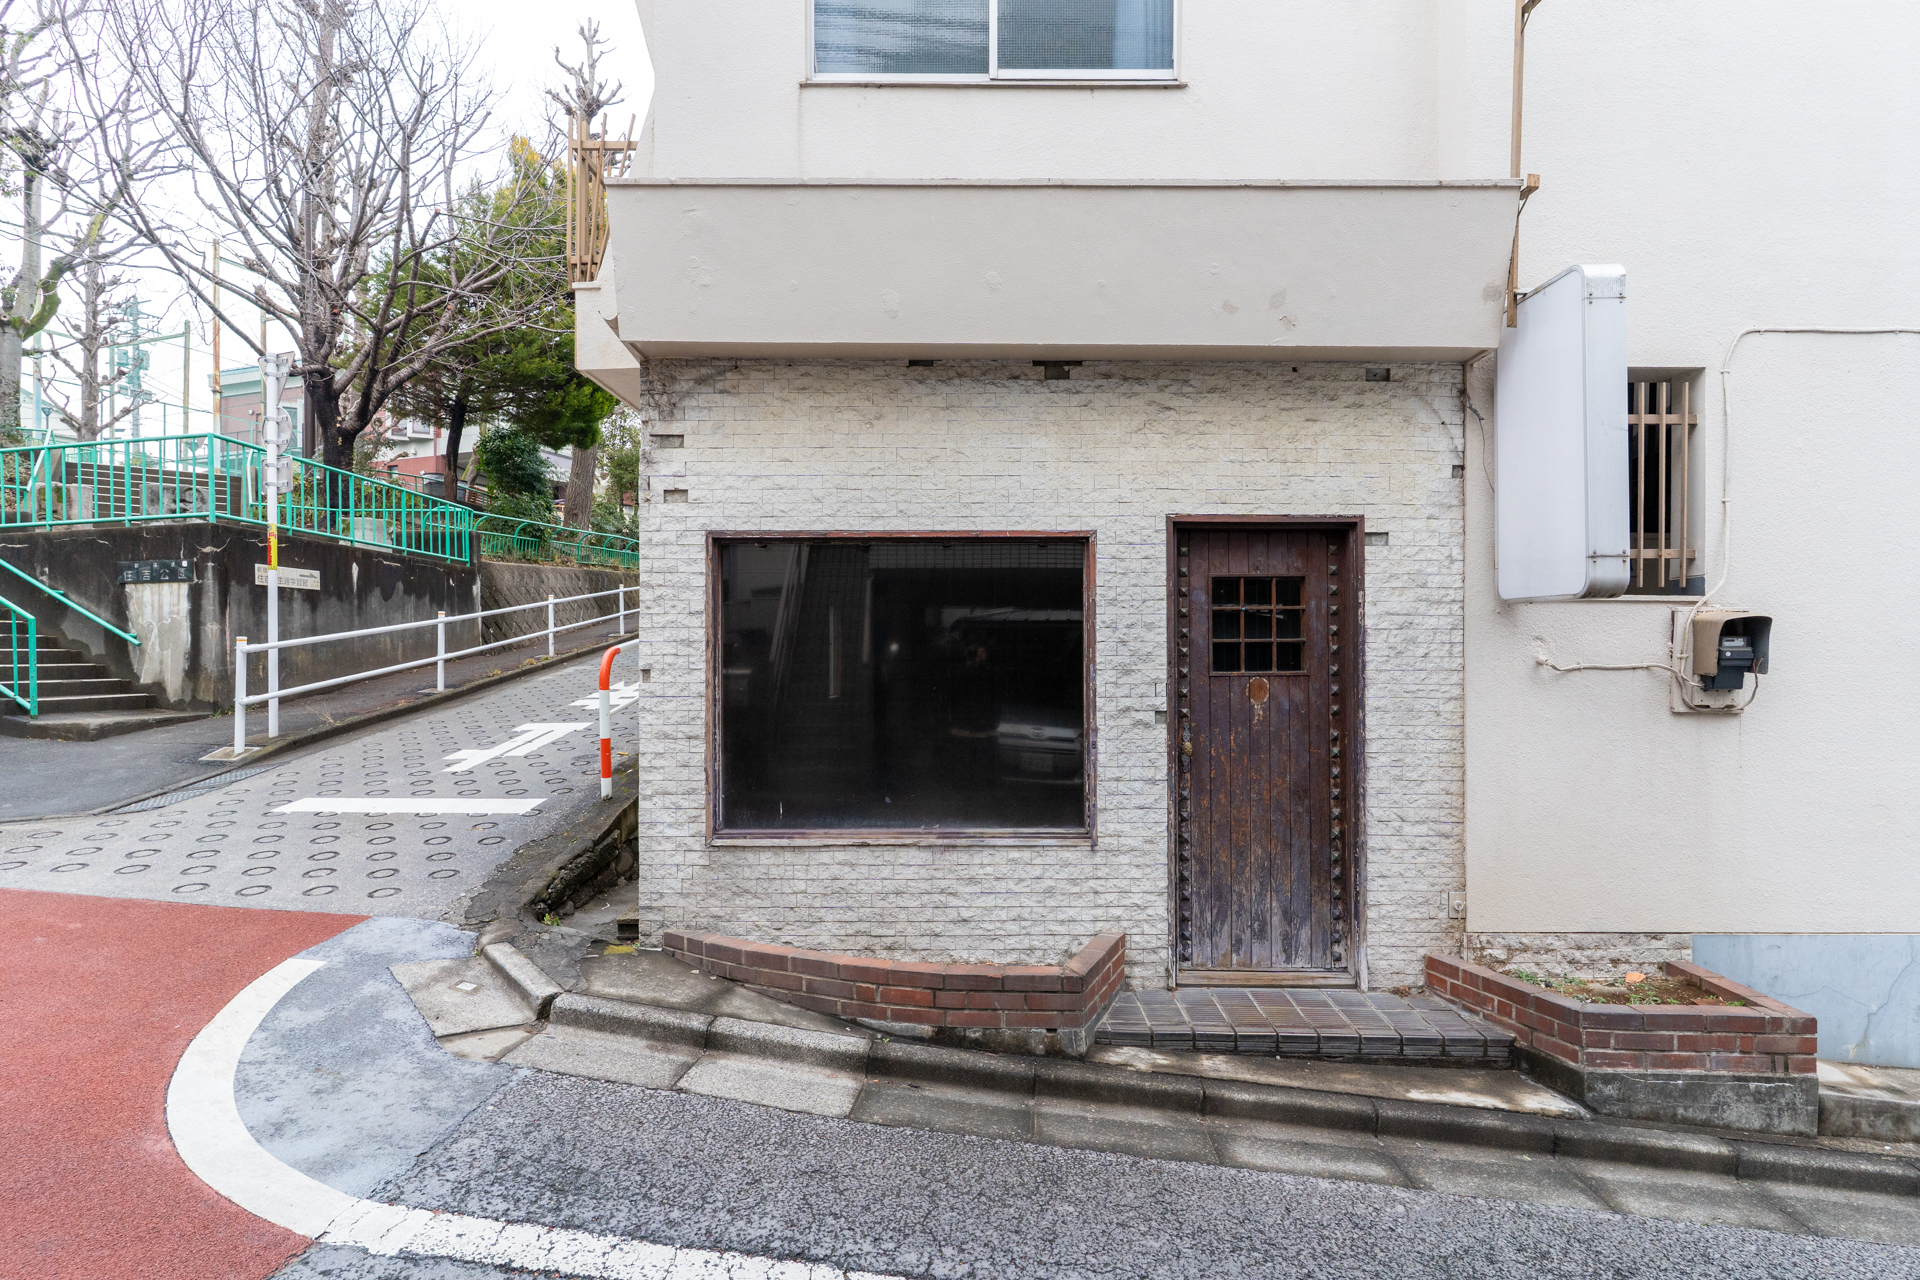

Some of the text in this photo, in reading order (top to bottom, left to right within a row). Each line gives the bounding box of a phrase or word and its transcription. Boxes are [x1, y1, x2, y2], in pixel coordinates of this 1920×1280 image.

[123, 568, 187, 581] 住吉公園
[257, 574, 309, 588] 住吉生涯学習館
